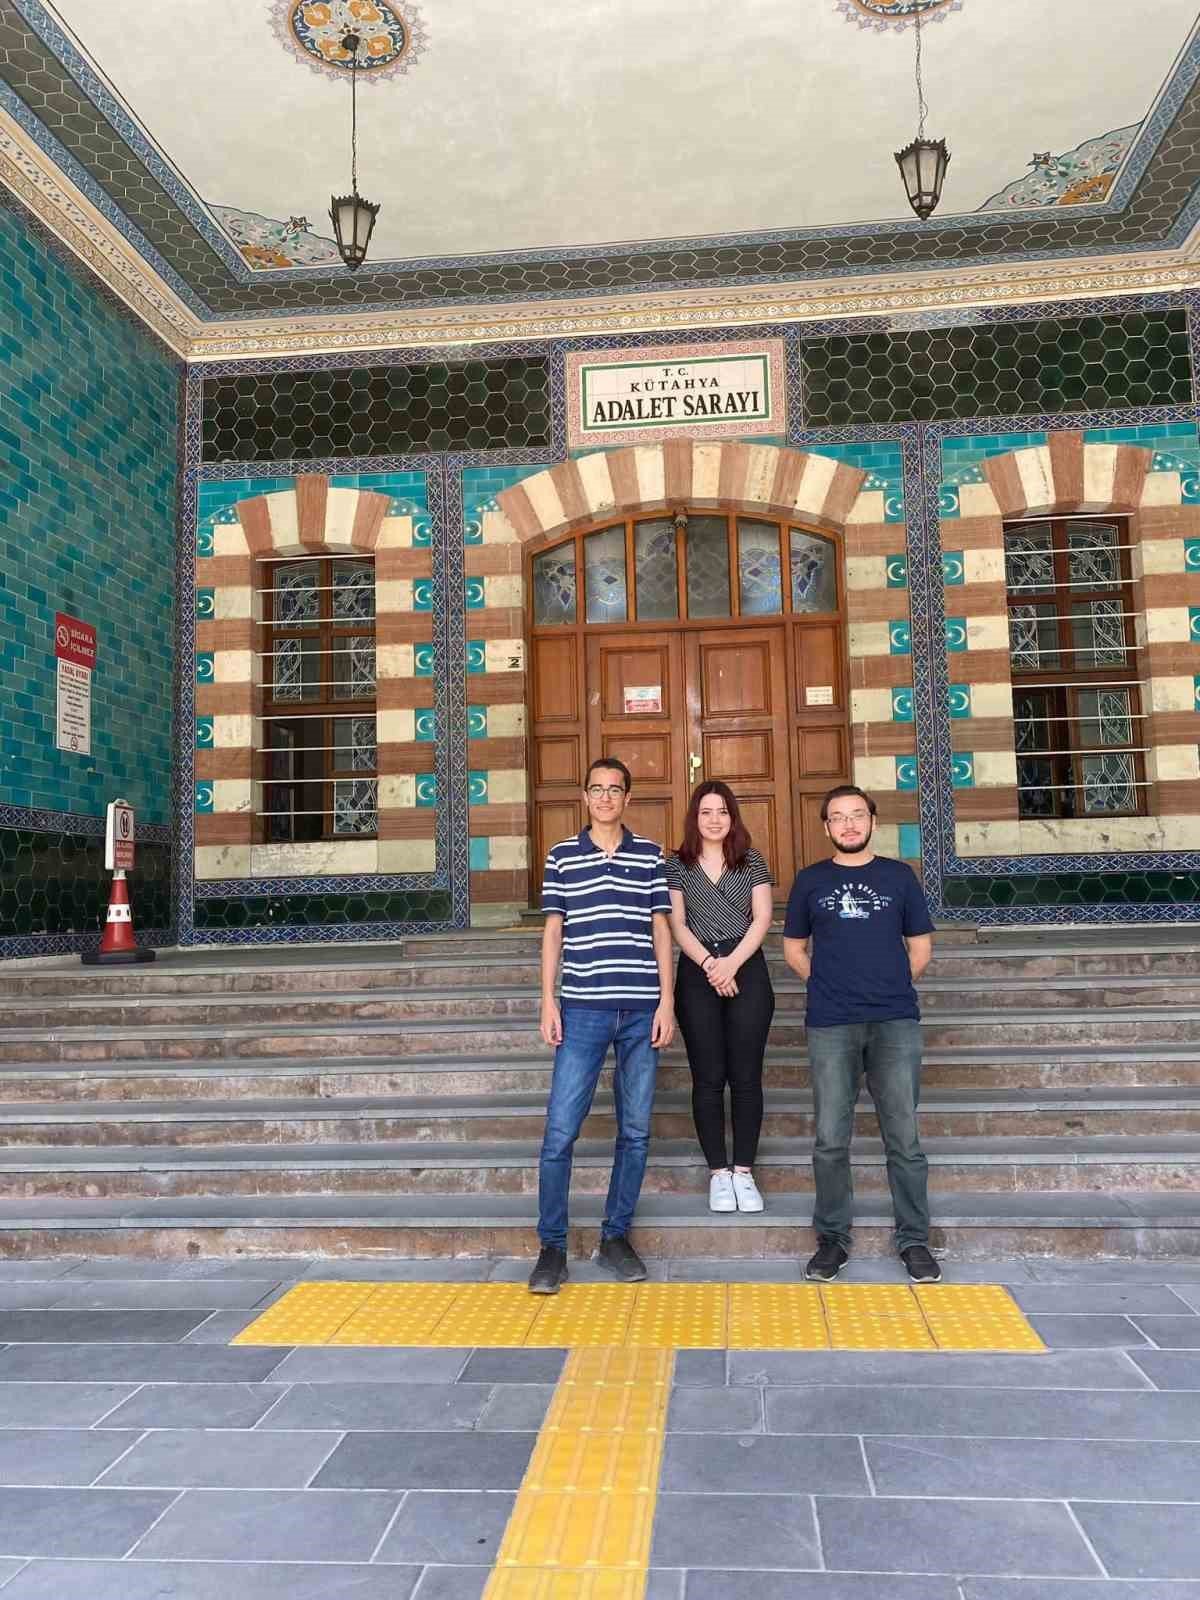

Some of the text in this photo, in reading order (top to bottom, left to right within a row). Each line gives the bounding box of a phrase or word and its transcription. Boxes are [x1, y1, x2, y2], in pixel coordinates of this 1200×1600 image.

[630, 377, 720, 393] KÜTAHYA
[593, 391, 760, 423] ADALET SARAYI
